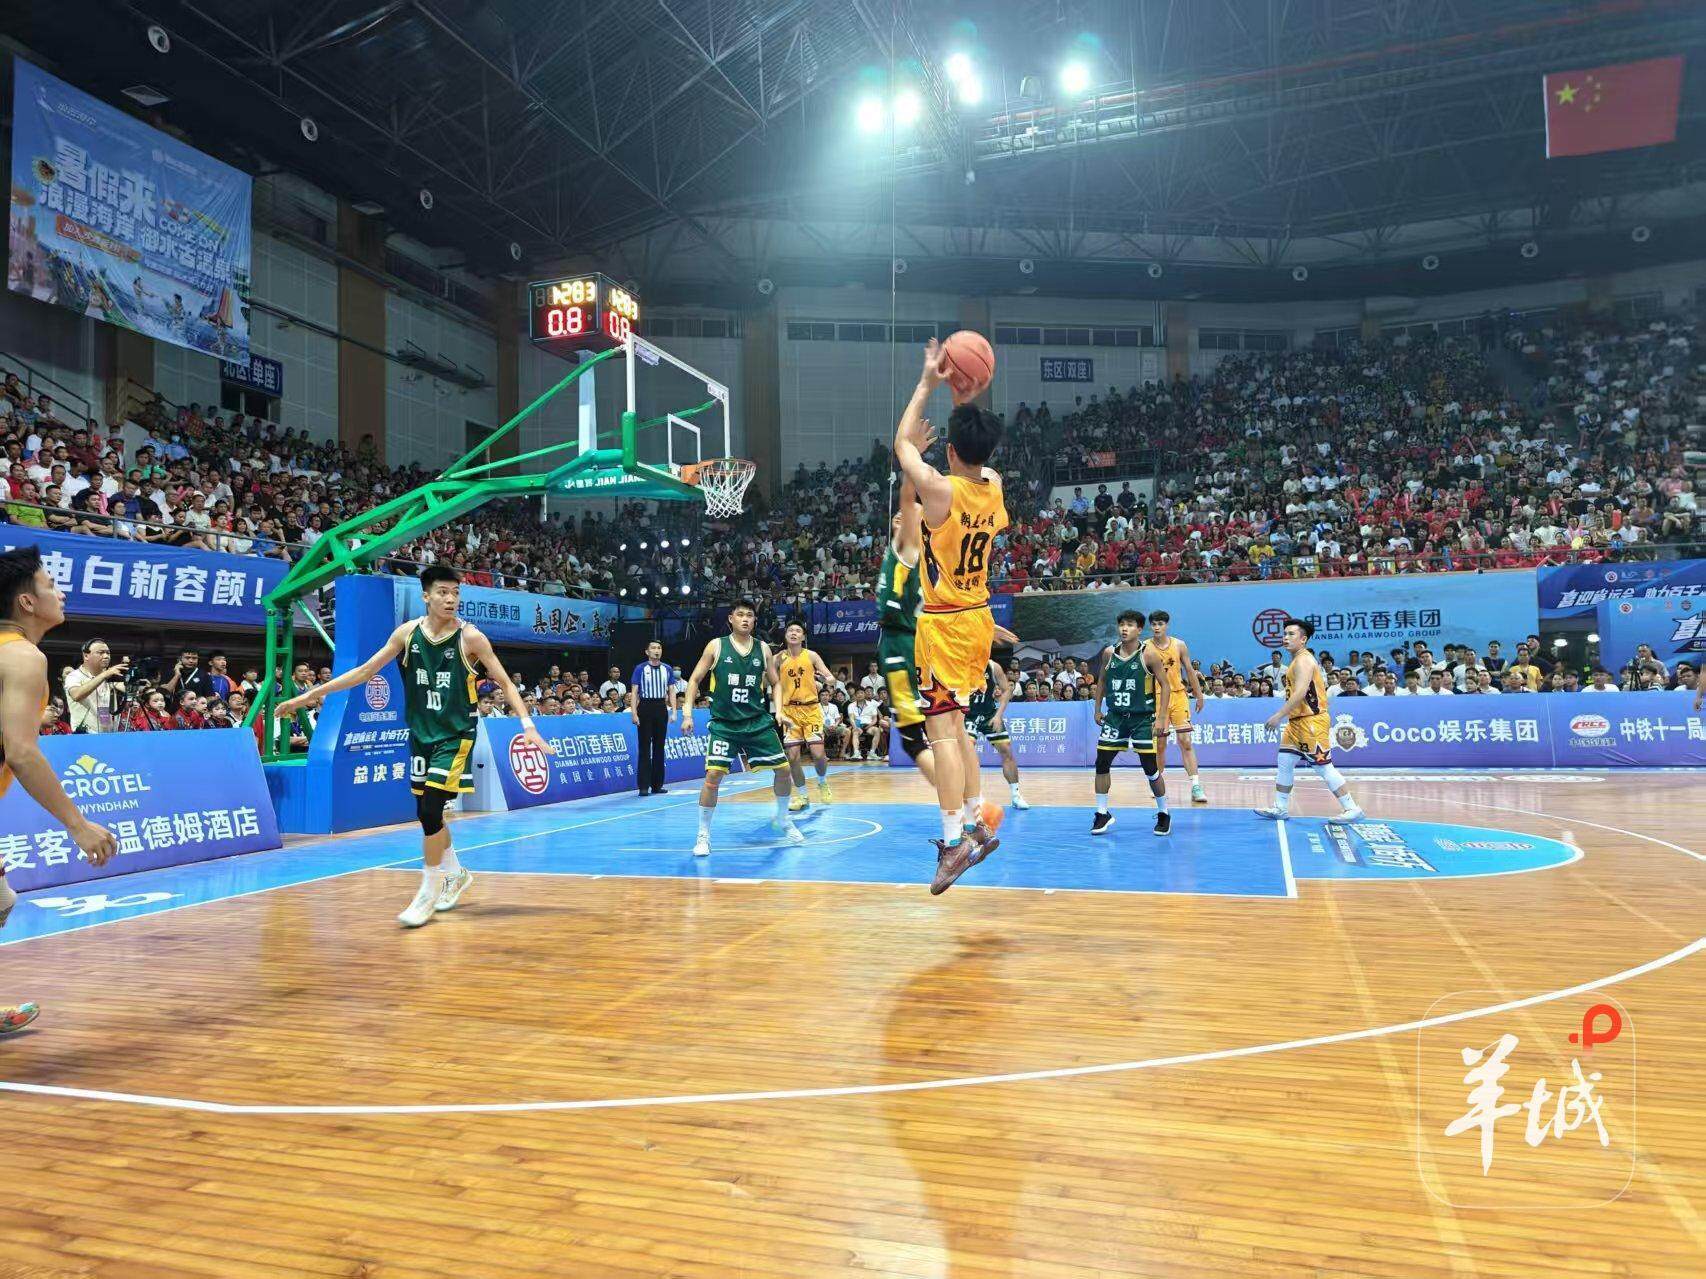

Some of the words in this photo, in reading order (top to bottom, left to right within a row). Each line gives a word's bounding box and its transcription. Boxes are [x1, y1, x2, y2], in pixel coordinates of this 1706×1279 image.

[55, 137, 158, 228] 暑假来
[547, 306, 583, 336] 0.8
[954, 531, 990, 575] 18
[1304, 608, 1442, 632] 电白沉香集团
[1408, 628, 1442, 638] GROUP
[426, 689, 442, 711] 10
[731, 687, 749, 704] 62
[1114, 691, 1131, 707] 33
[1101, 724, 1119, 740] 33
[1371, 717, 1540, 744] Coco娱乐集团
[1619, 717, 1706, 742] 中铁十一局
[549, 732, 628, 759] 电白沉香集团
[712, 739, 730, 757] 62
[612, 753, 631, 764] GROUP
[353, 762, 406, 785] 总决赛
[0, 806, 261, 873] 麦客温德姆酒店
